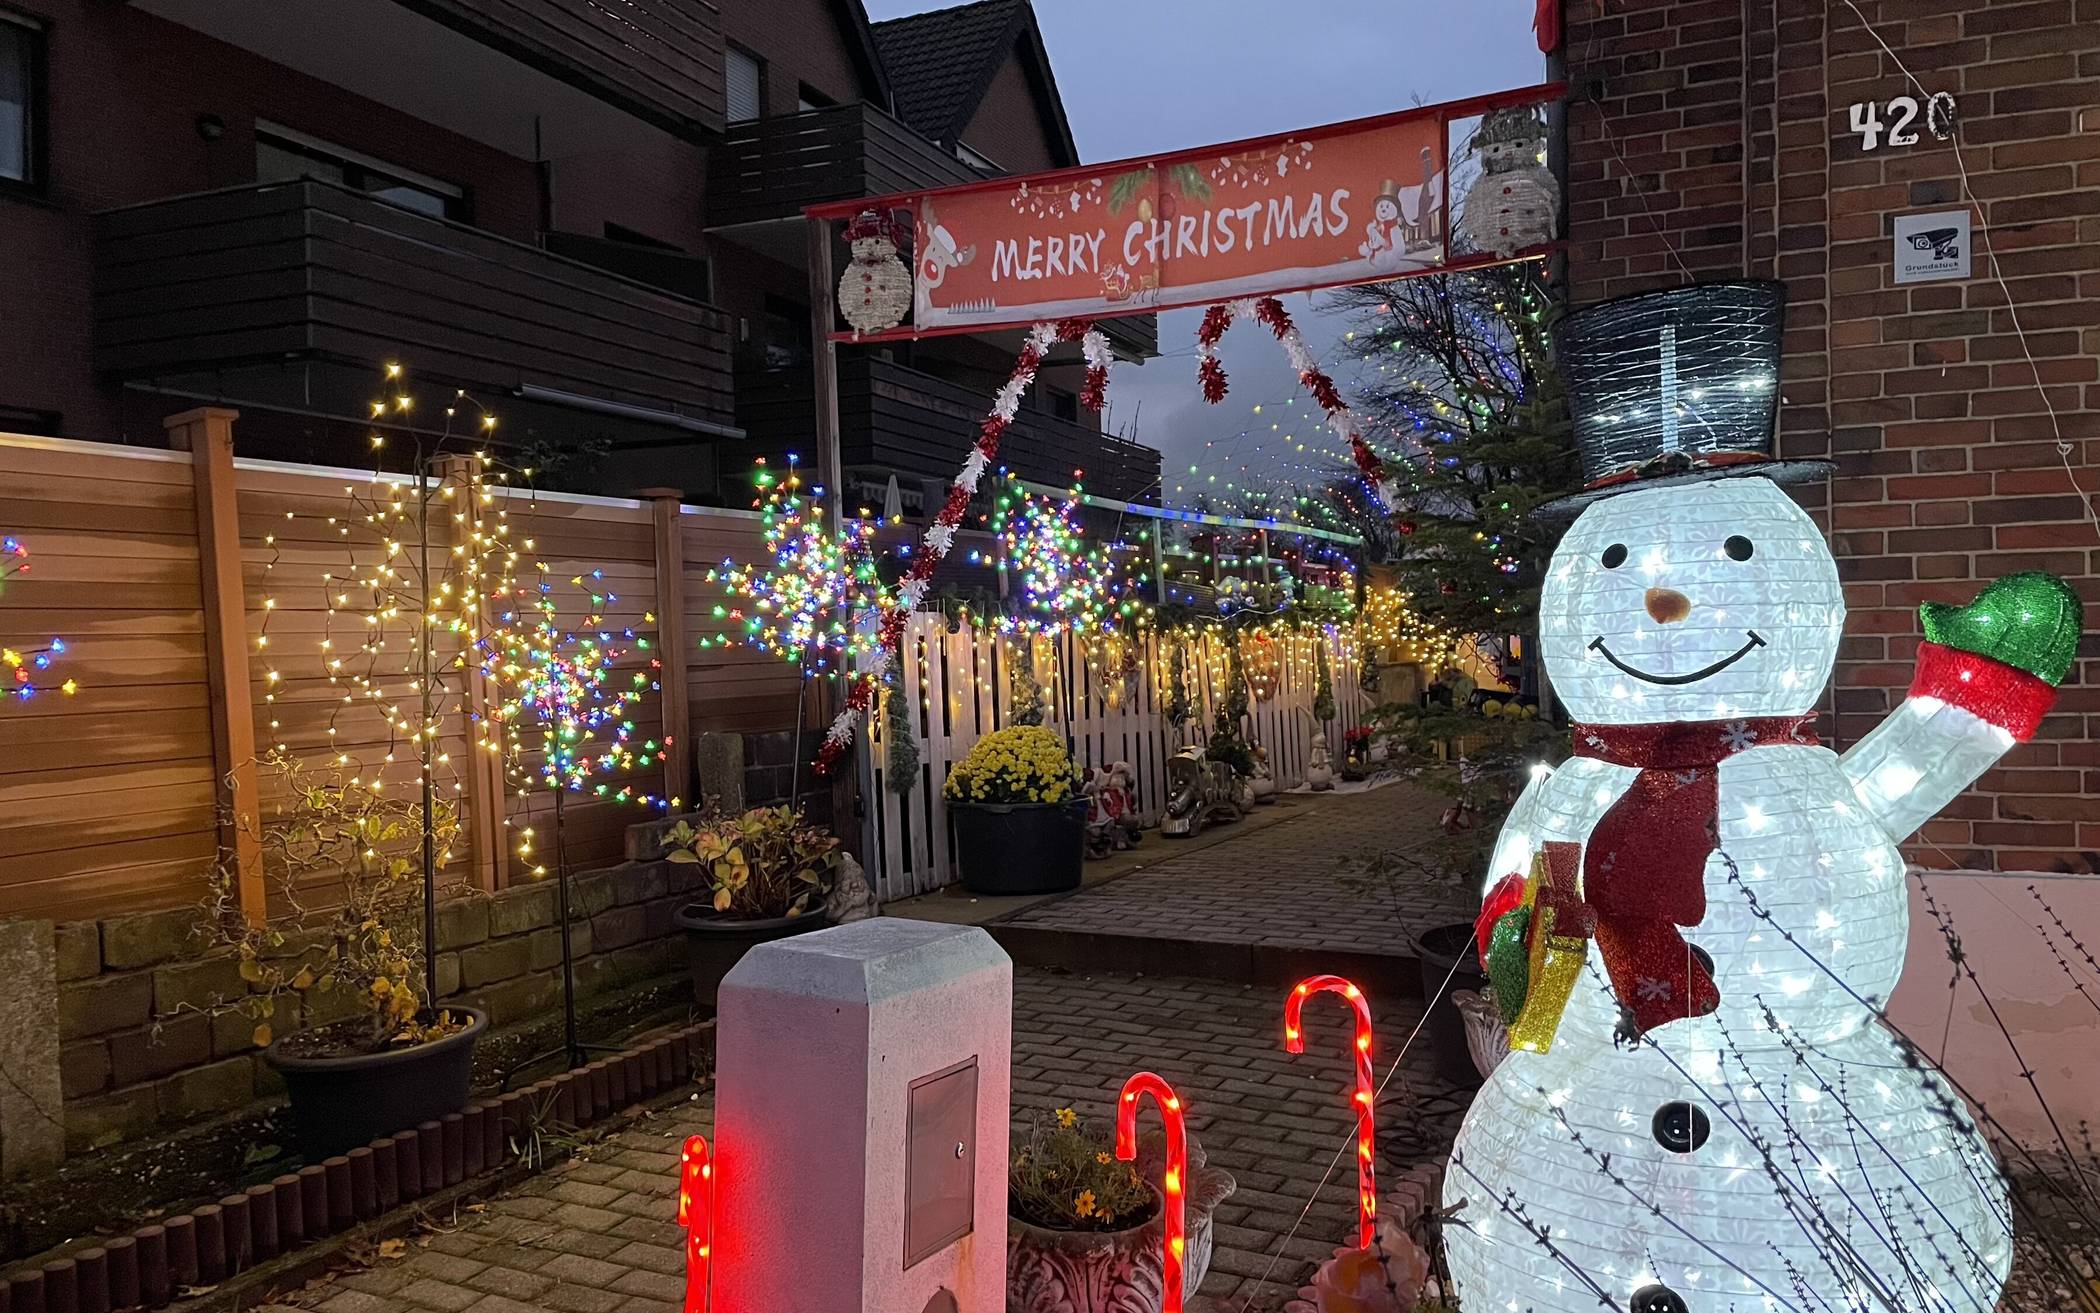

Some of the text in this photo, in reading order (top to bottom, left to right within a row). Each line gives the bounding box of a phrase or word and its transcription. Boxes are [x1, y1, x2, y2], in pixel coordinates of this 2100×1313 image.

[1849, 91, 1957, 151] 420
[991, 188, 1351, 282] MERRY CHRISTMAS
